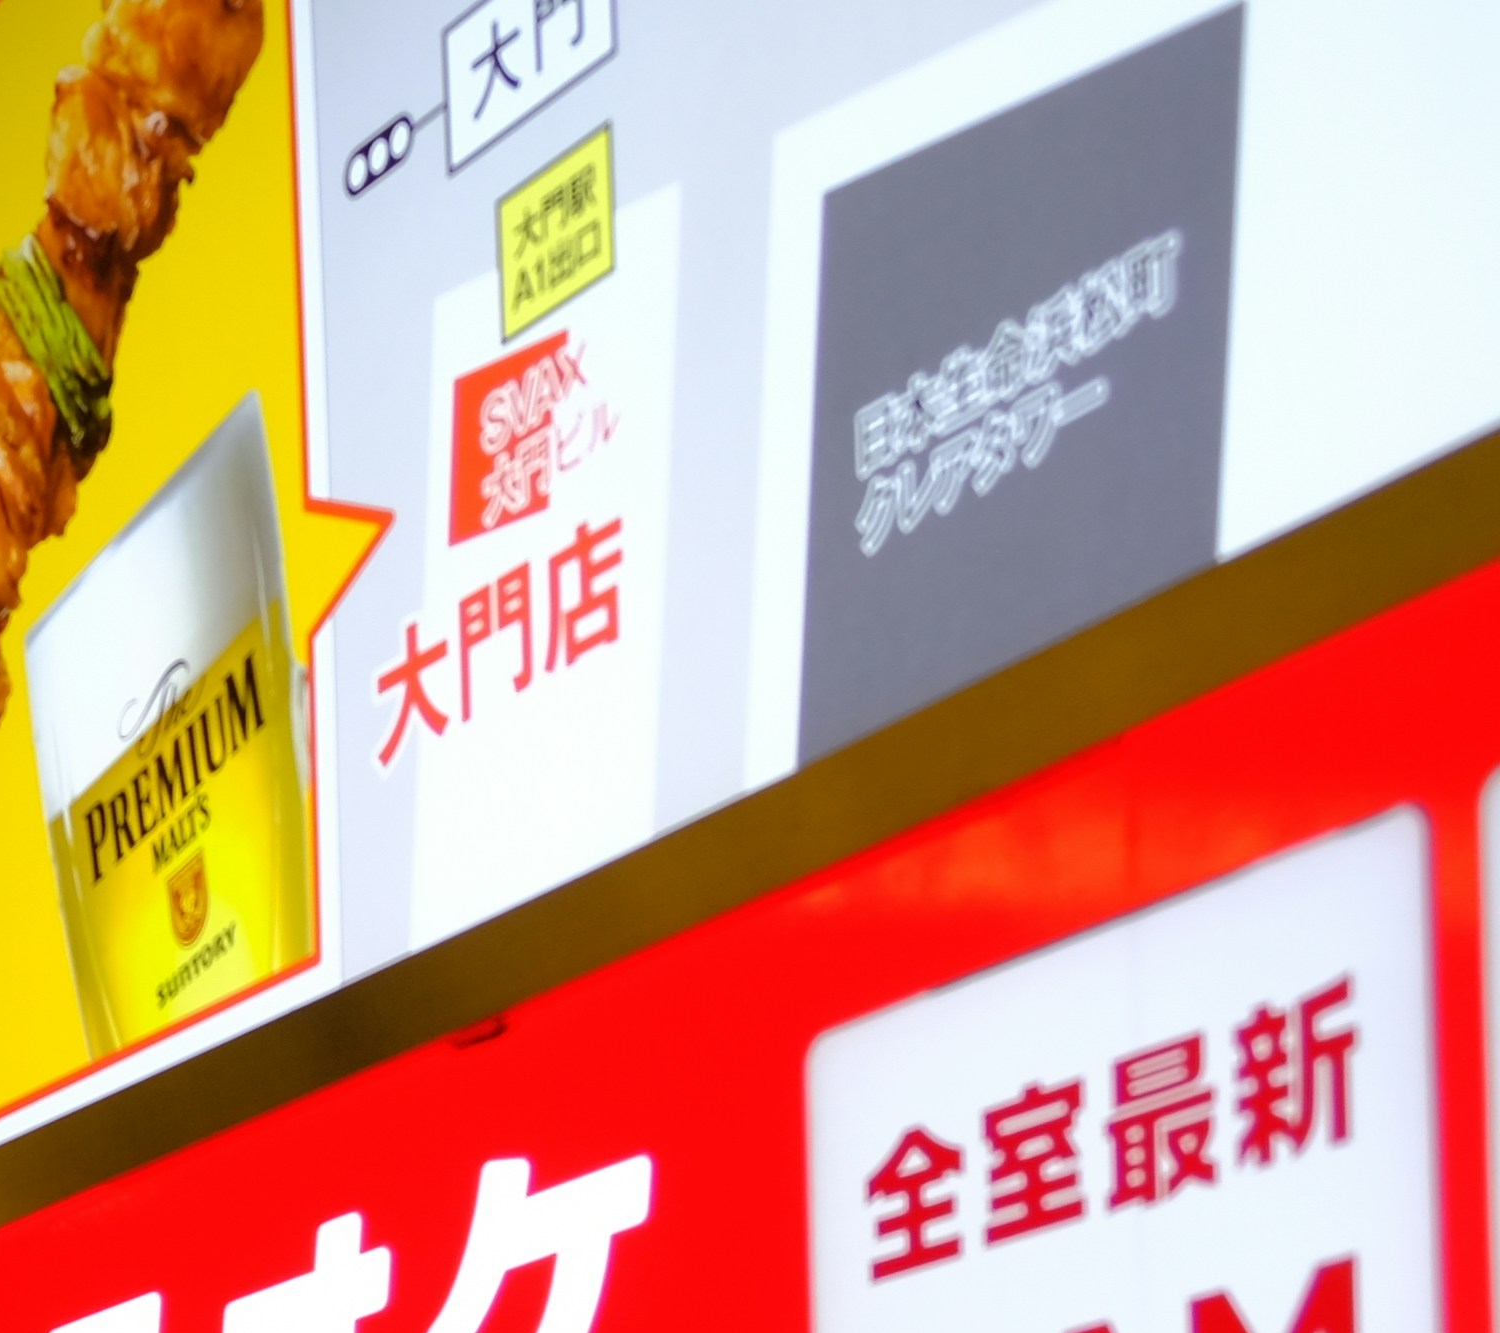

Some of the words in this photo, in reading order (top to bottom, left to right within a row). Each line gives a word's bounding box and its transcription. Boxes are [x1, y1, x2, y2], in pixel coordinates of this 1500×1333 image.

[83, 650, 265, 888] PREMIUM
[375, 517, 625, 769] 大門店
[864, 968, 1361, 1284] 全室最新
